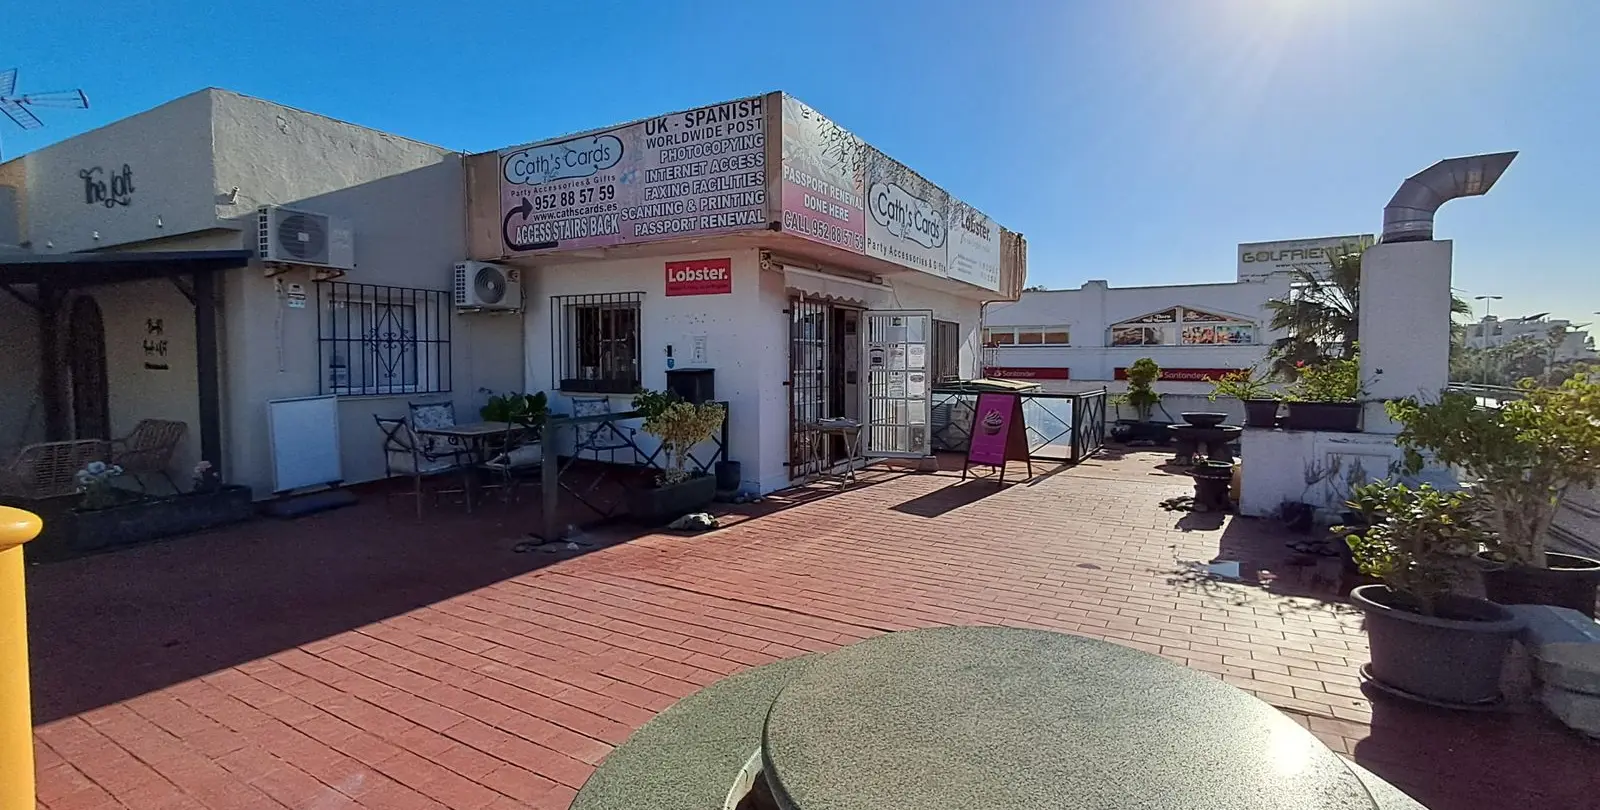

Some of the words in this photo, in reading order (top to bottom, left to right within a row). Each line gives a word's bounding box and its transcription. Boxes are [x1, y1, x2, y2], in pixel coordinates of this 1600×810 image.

[645, 117, 668, 136] UK
[685, 100, 762, 129] SPANISH
[646, 125, 722, 149] WORLDWIDE
[727, 118, 762, 135] POST
[515, 154, 560, 176] Cath's
[565, 144, 610, 167] Cards
[660, 133, 764, 164] PHOTOCOPYING
[645, 162, 707, 183] INTERNET
[710, 152, 764, 173] ACCESS
[80, 166, 107, 204] The
[511, 189, 531, 198] Party
[534, 181, 585, 193] Accessories
[594, 174, 615, 183] Gifts
[535, 193, 556, 210] 952
[560, 191, 575, 207] 88
[580, 188, 594, 203] 57
[599, 185, 615, 201] 59
[645, 181, 690, 201] FAXING
[692, 171, 765, 194] FACILITIES
[783, 165, 828, 195] PASSPORT
[830, 185, 864, 211] RENEWAL
[533, 203, 618, 221] www.cathscards.es
[621, 201, 683, 221] SCANNING
[687, 199, 697, 213] &
[700, 190, 765, 212] PRINTING
[804, 194, 828, 214] DONE
[829, 203, 849, 222] HERE
[878, 192, 912, 228] Cath's
[914, 210, 940, 239] Cards
[515, 221, 553, 245] ACCESS
[552, 217, 588, 241] STAIRS
[590, 213, 620, 237] BACK
[634, 217, 697, 237] PASSPORT
[700, 209, 765, 232] RENEWAL
[784, 209, 810, 235] CALL
[812, 219, 829, 240] 952
[831, 225, 841, 244] 88
[843, 229, 854, 248] 57
[854, 232, 864, 251] 59
[868, 238, 887, 256] Party
[668, 266, 728, 282] Lobster.
